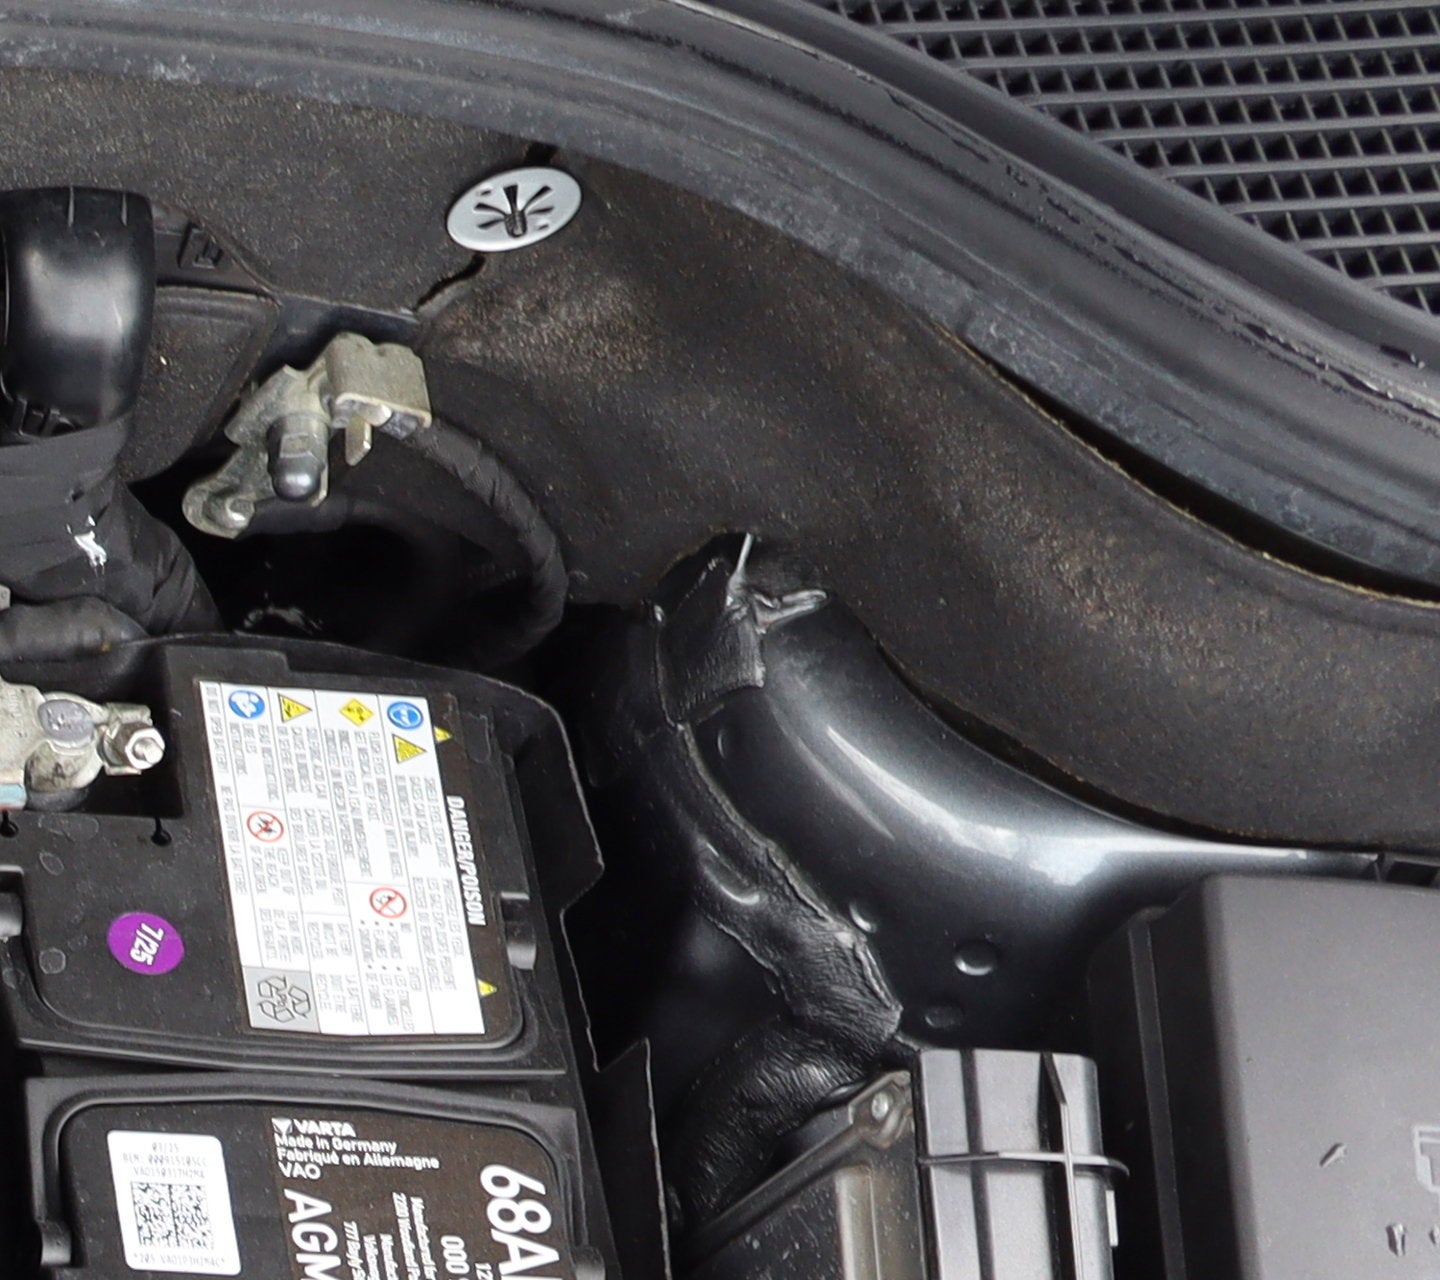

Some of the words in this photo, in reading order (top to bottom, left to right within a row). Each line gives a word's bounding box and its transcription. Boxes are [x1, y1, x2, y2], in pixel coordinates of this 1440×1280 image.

[447, 796, 485, 926] DANGER/POISON
[293, 1119, 356, 1137] VARTA
[275, 1133, 313, 1148] Made
[332, 1137, 397, 1155] Germany
[276, 1147, 339, 1166] Fabriqué
[342, 1153, 360, 1166] en
[363, 1153, 439, 1171] Allemagne
[278, 1162, 321, 1179] VAO
[441, 1236, 467, 1273] 000
